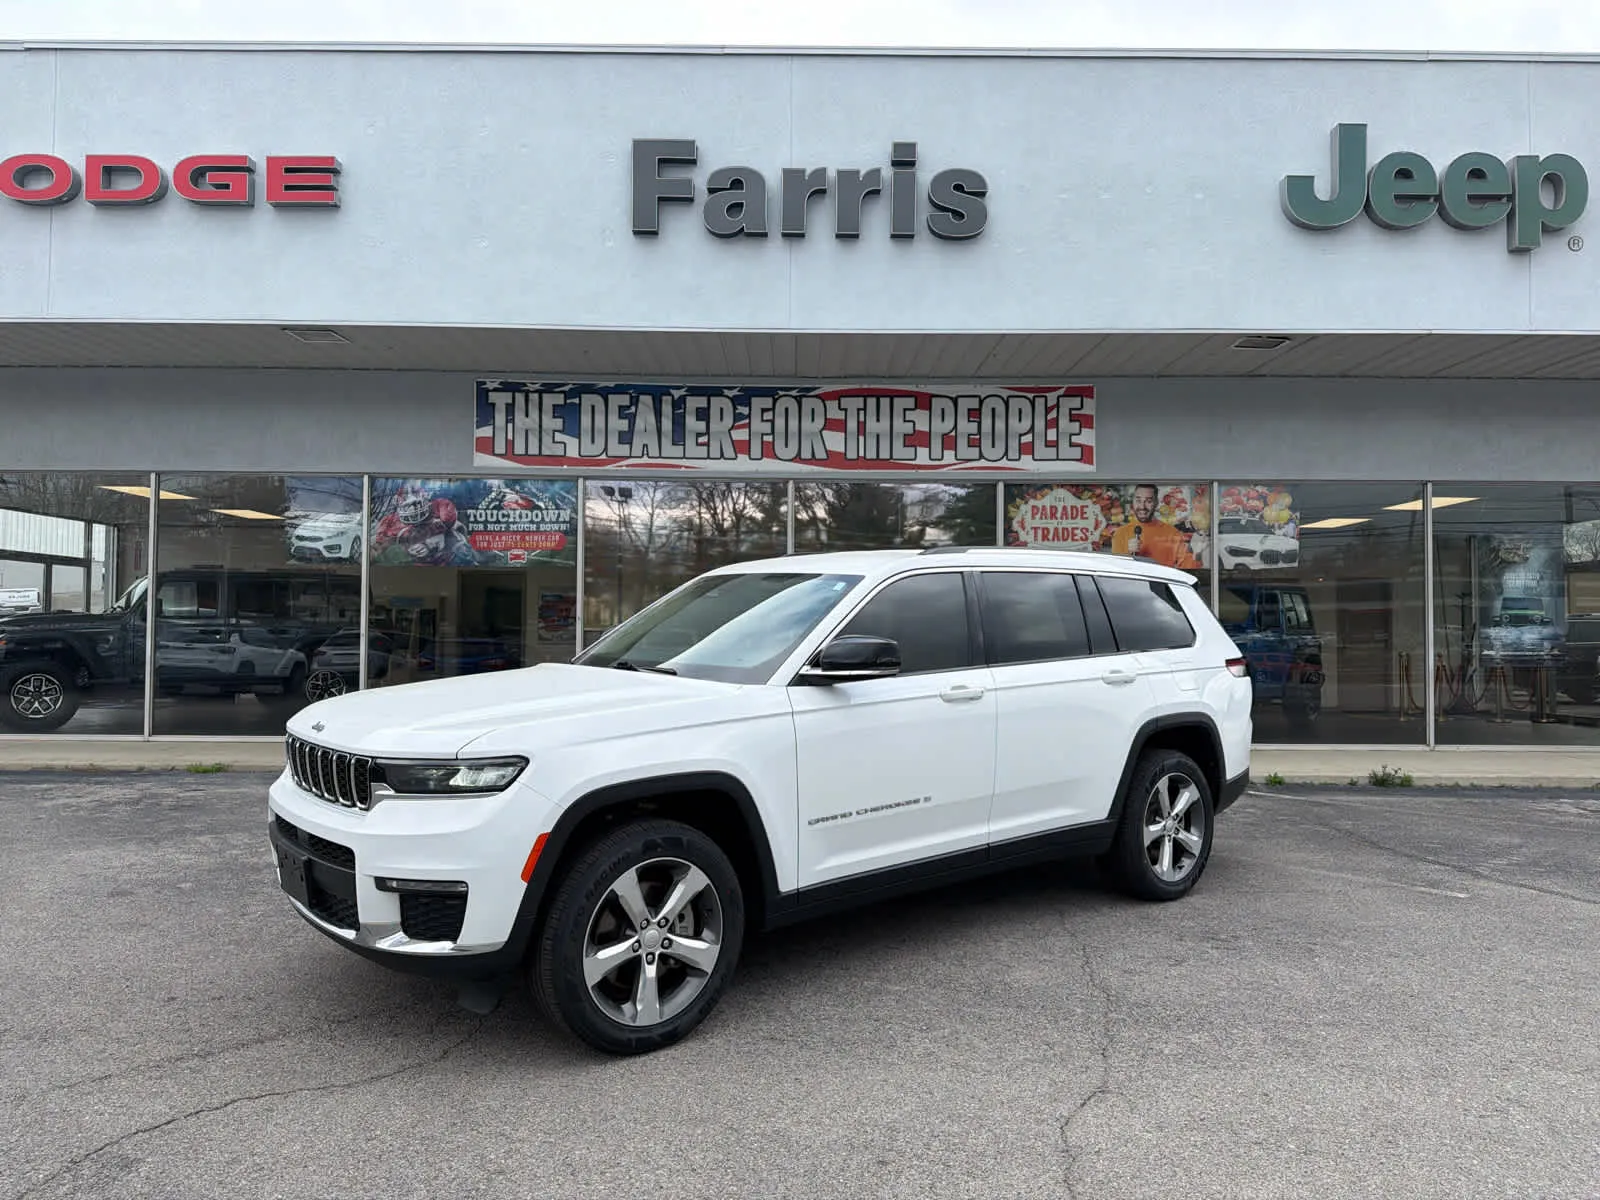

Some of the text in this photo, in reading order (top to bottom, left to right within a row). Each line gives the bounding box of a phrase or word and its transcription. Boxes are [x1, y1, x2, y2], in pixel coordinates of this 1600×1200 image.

[632, 138, 988, 240] Farris
[1279, 122, 1590, 253] Jeep
[487, 390, 1084, 463] THE DEALER FOR THE PEOPLE
[467, 509, 571, 522] TOUCHDOWN
[1031, 504, 1089, 520] PARADE
[468, 523, 484, 531] FOR
[487, 523, 507, 531] NOT
[509, 523, 537, 531] MUCH
[1031, 526, 1090, 542] TRADES
